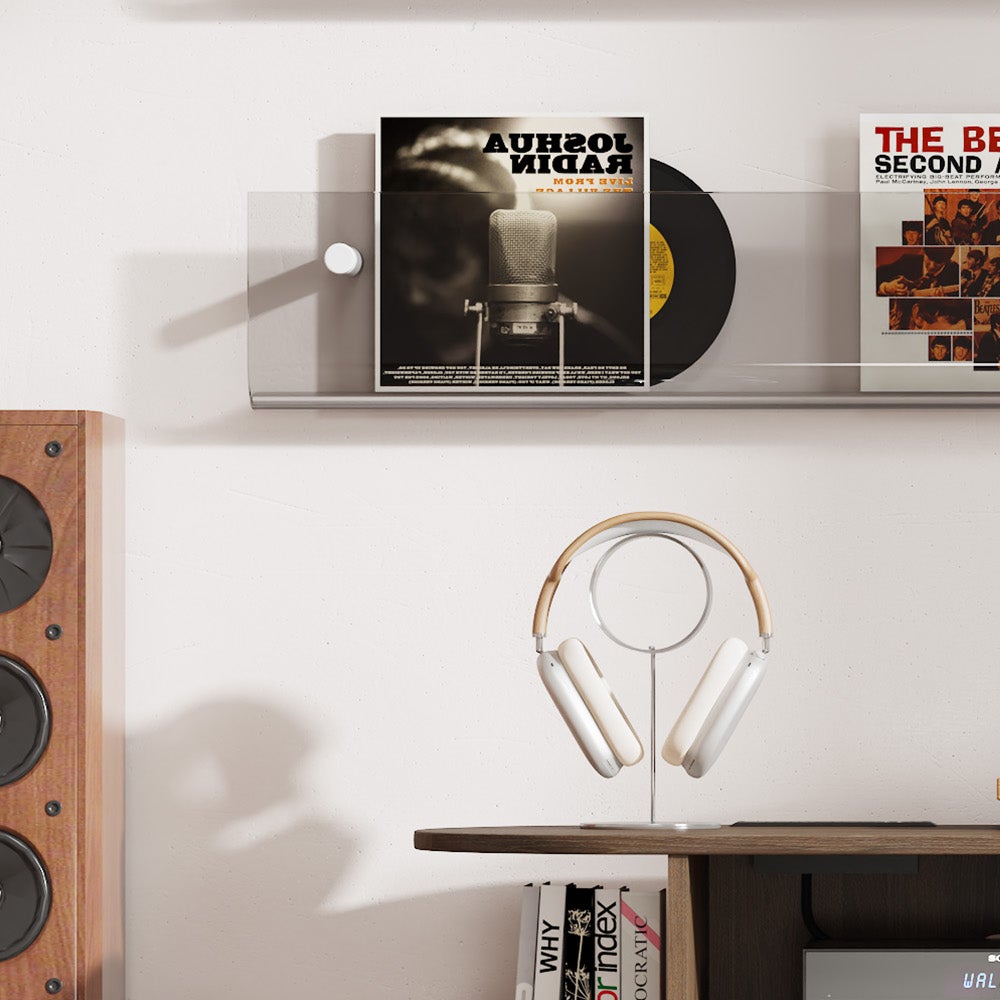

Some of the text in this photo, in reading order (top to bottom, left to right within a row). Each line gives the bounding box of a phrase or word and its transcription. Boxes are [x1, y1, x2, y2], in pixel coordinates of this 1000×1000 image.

[875, 126, 944, 153] THE
[875, 155, 981, 173] SECOND
[540, 920, 560, 973] WHY
[594, 901, 618, 972] index
